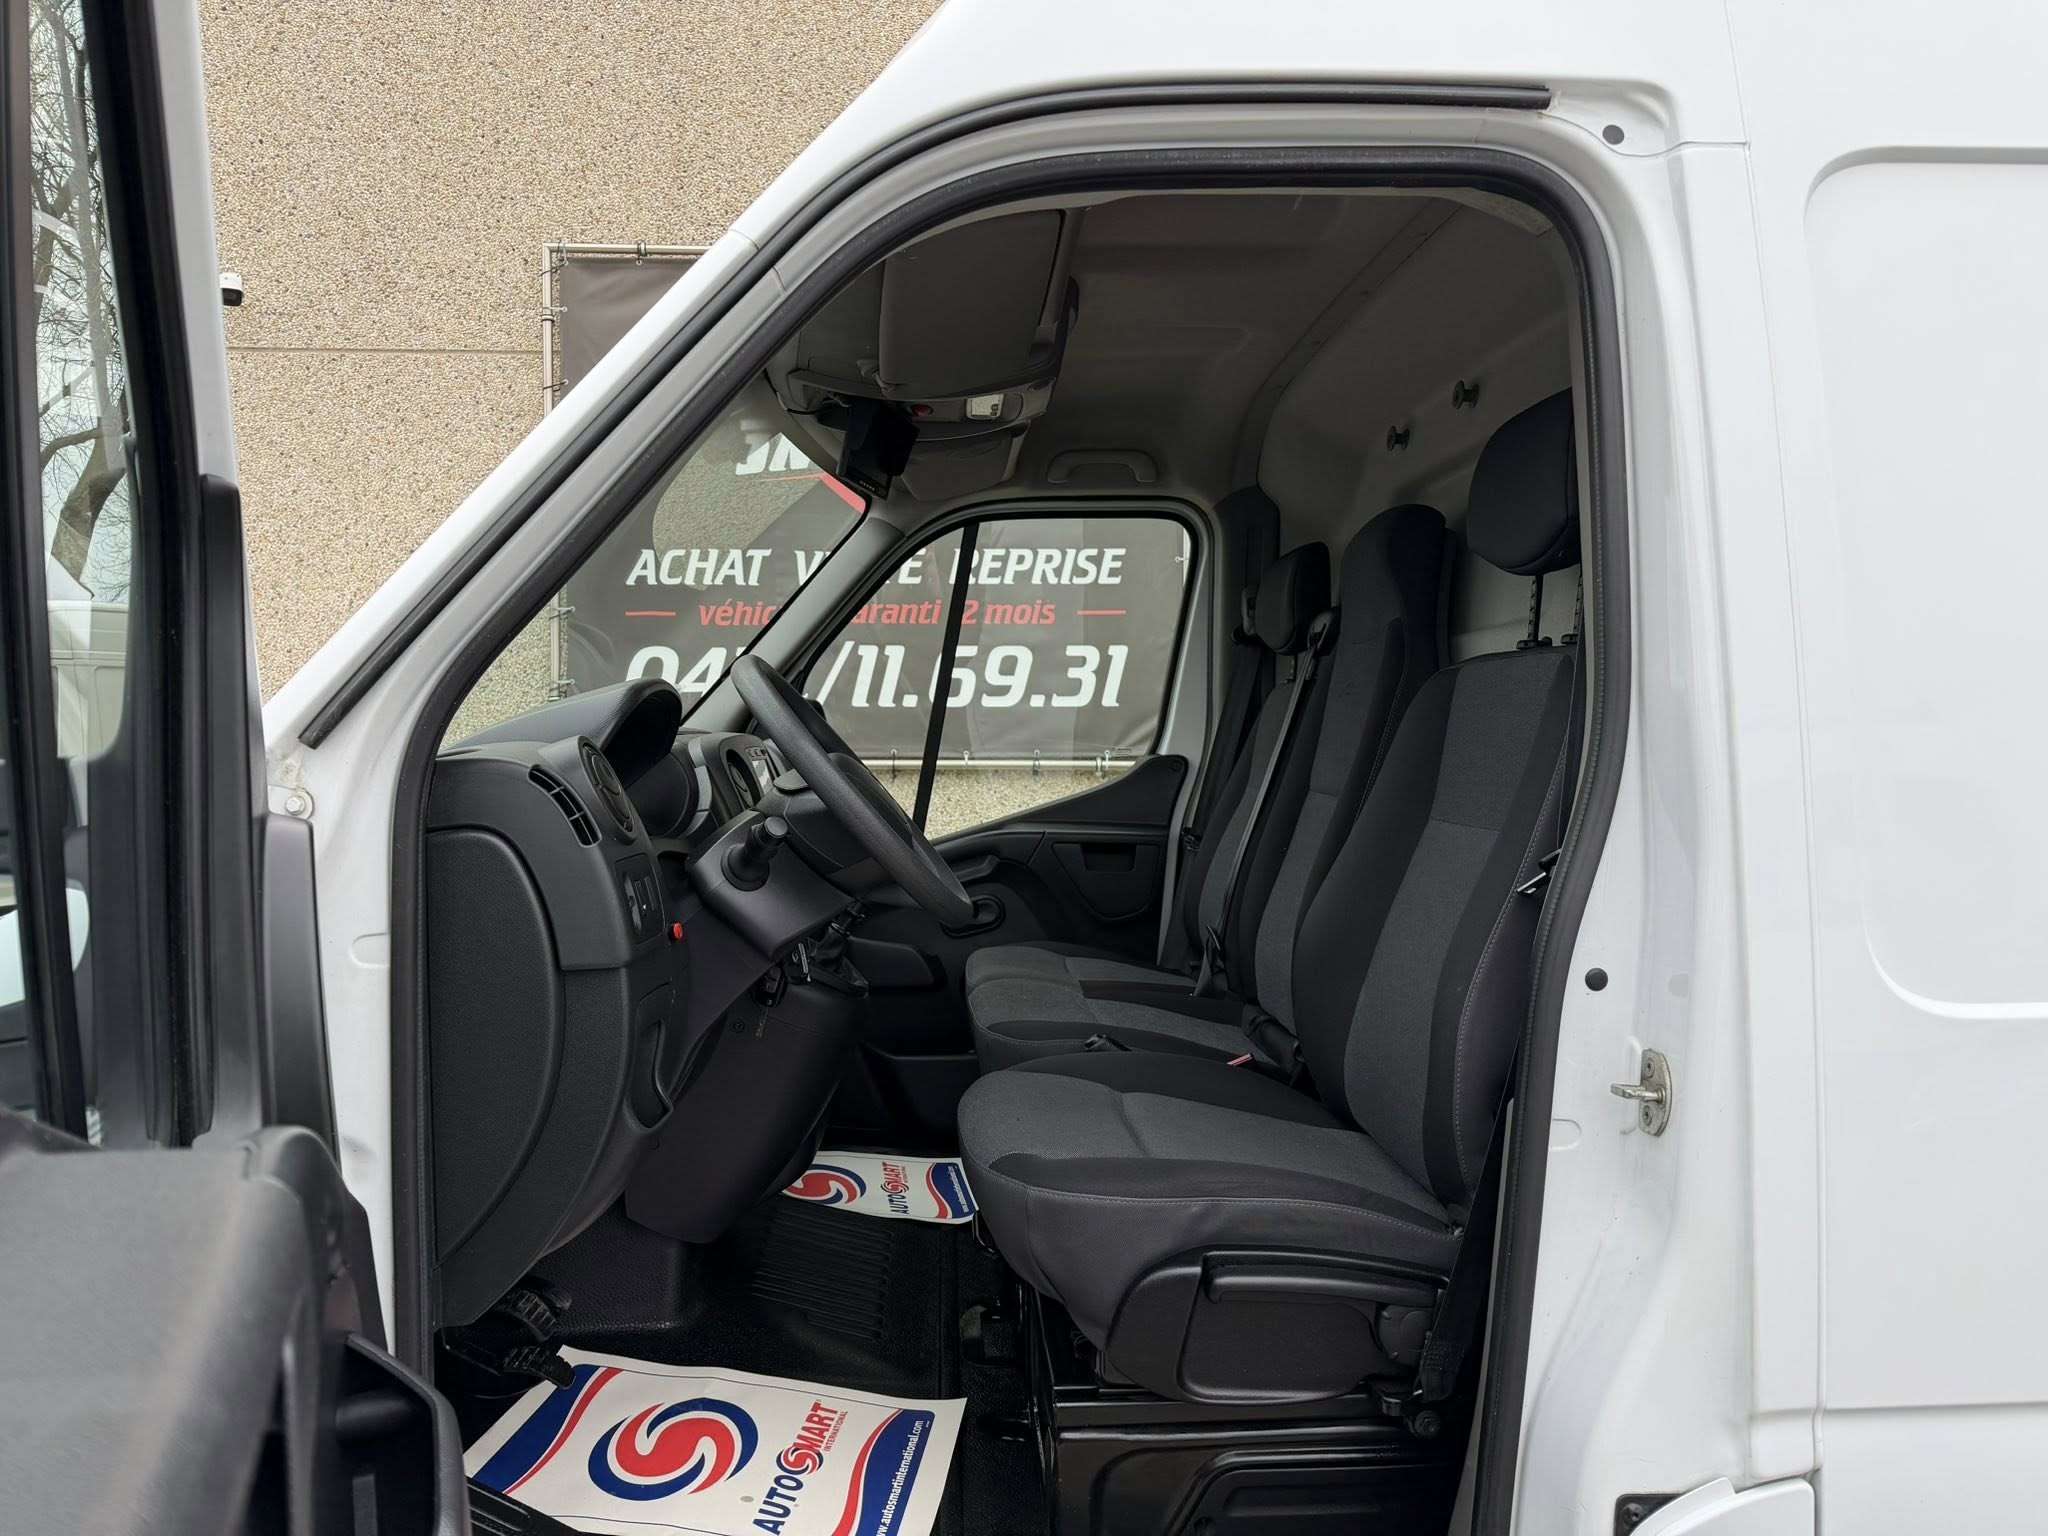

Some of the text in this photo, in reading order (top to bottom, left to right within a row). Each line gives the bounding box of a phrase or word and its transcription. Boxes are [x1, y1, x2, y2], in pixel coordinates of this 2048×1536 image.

[625, 548, 772, 586] ACHAT
[949, 548, 1126, 585] REPRISE
[699, 599, 1056, 626] véhic aranti 2 mois
[625, 641, 1129, 708] 04/11.69.31
